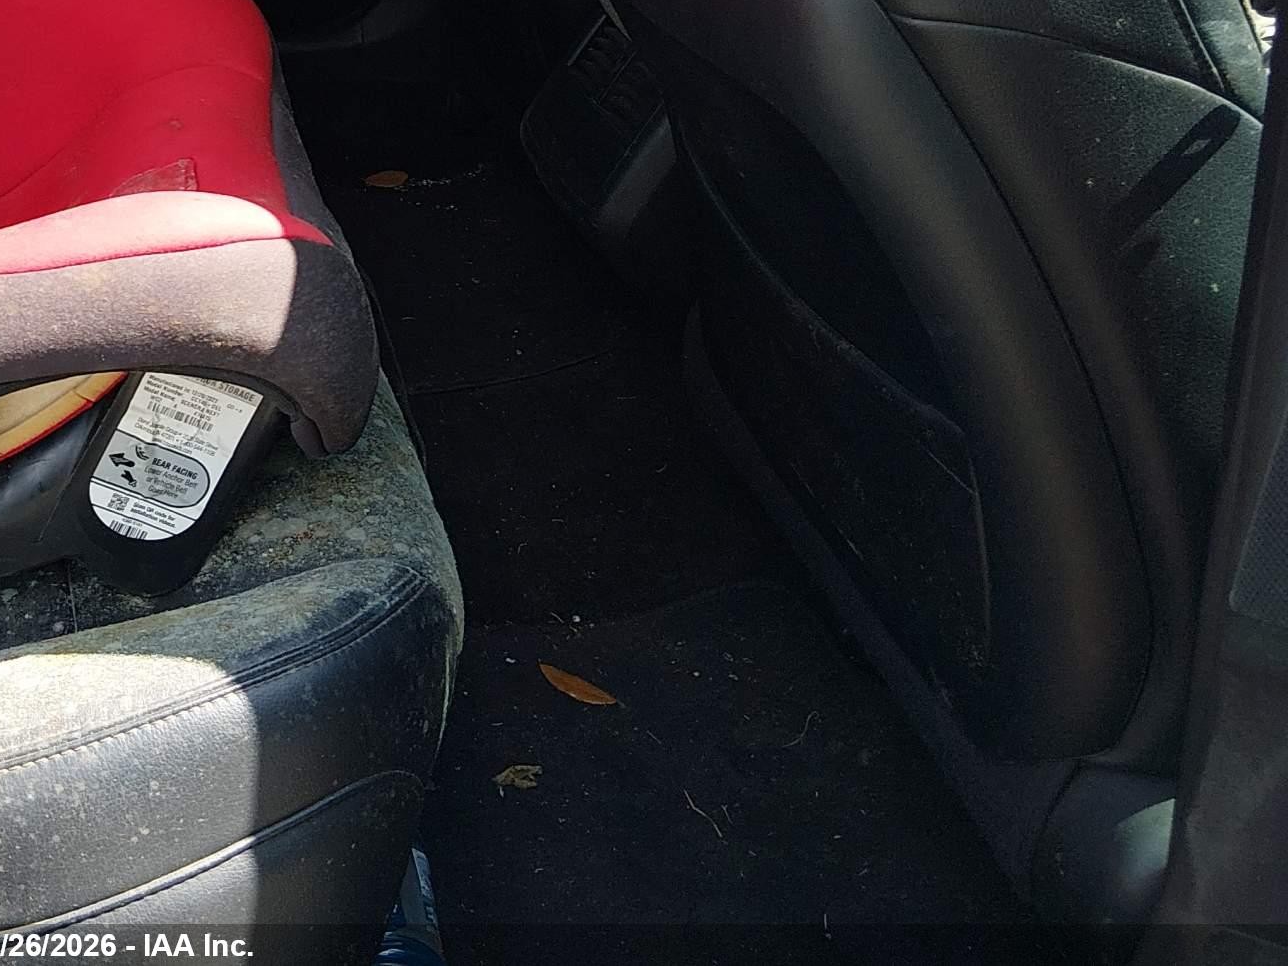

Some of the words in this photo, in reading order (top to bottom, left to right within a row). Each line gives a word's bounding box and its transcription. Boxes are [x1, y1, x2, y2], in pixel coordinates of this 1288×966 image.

[219, 383, 255, 402] STORAGE
[152, 457, 171, 470] REAR
[172, 465, 198, 480] FACING
[162, 472, 184, 484] Anchor
